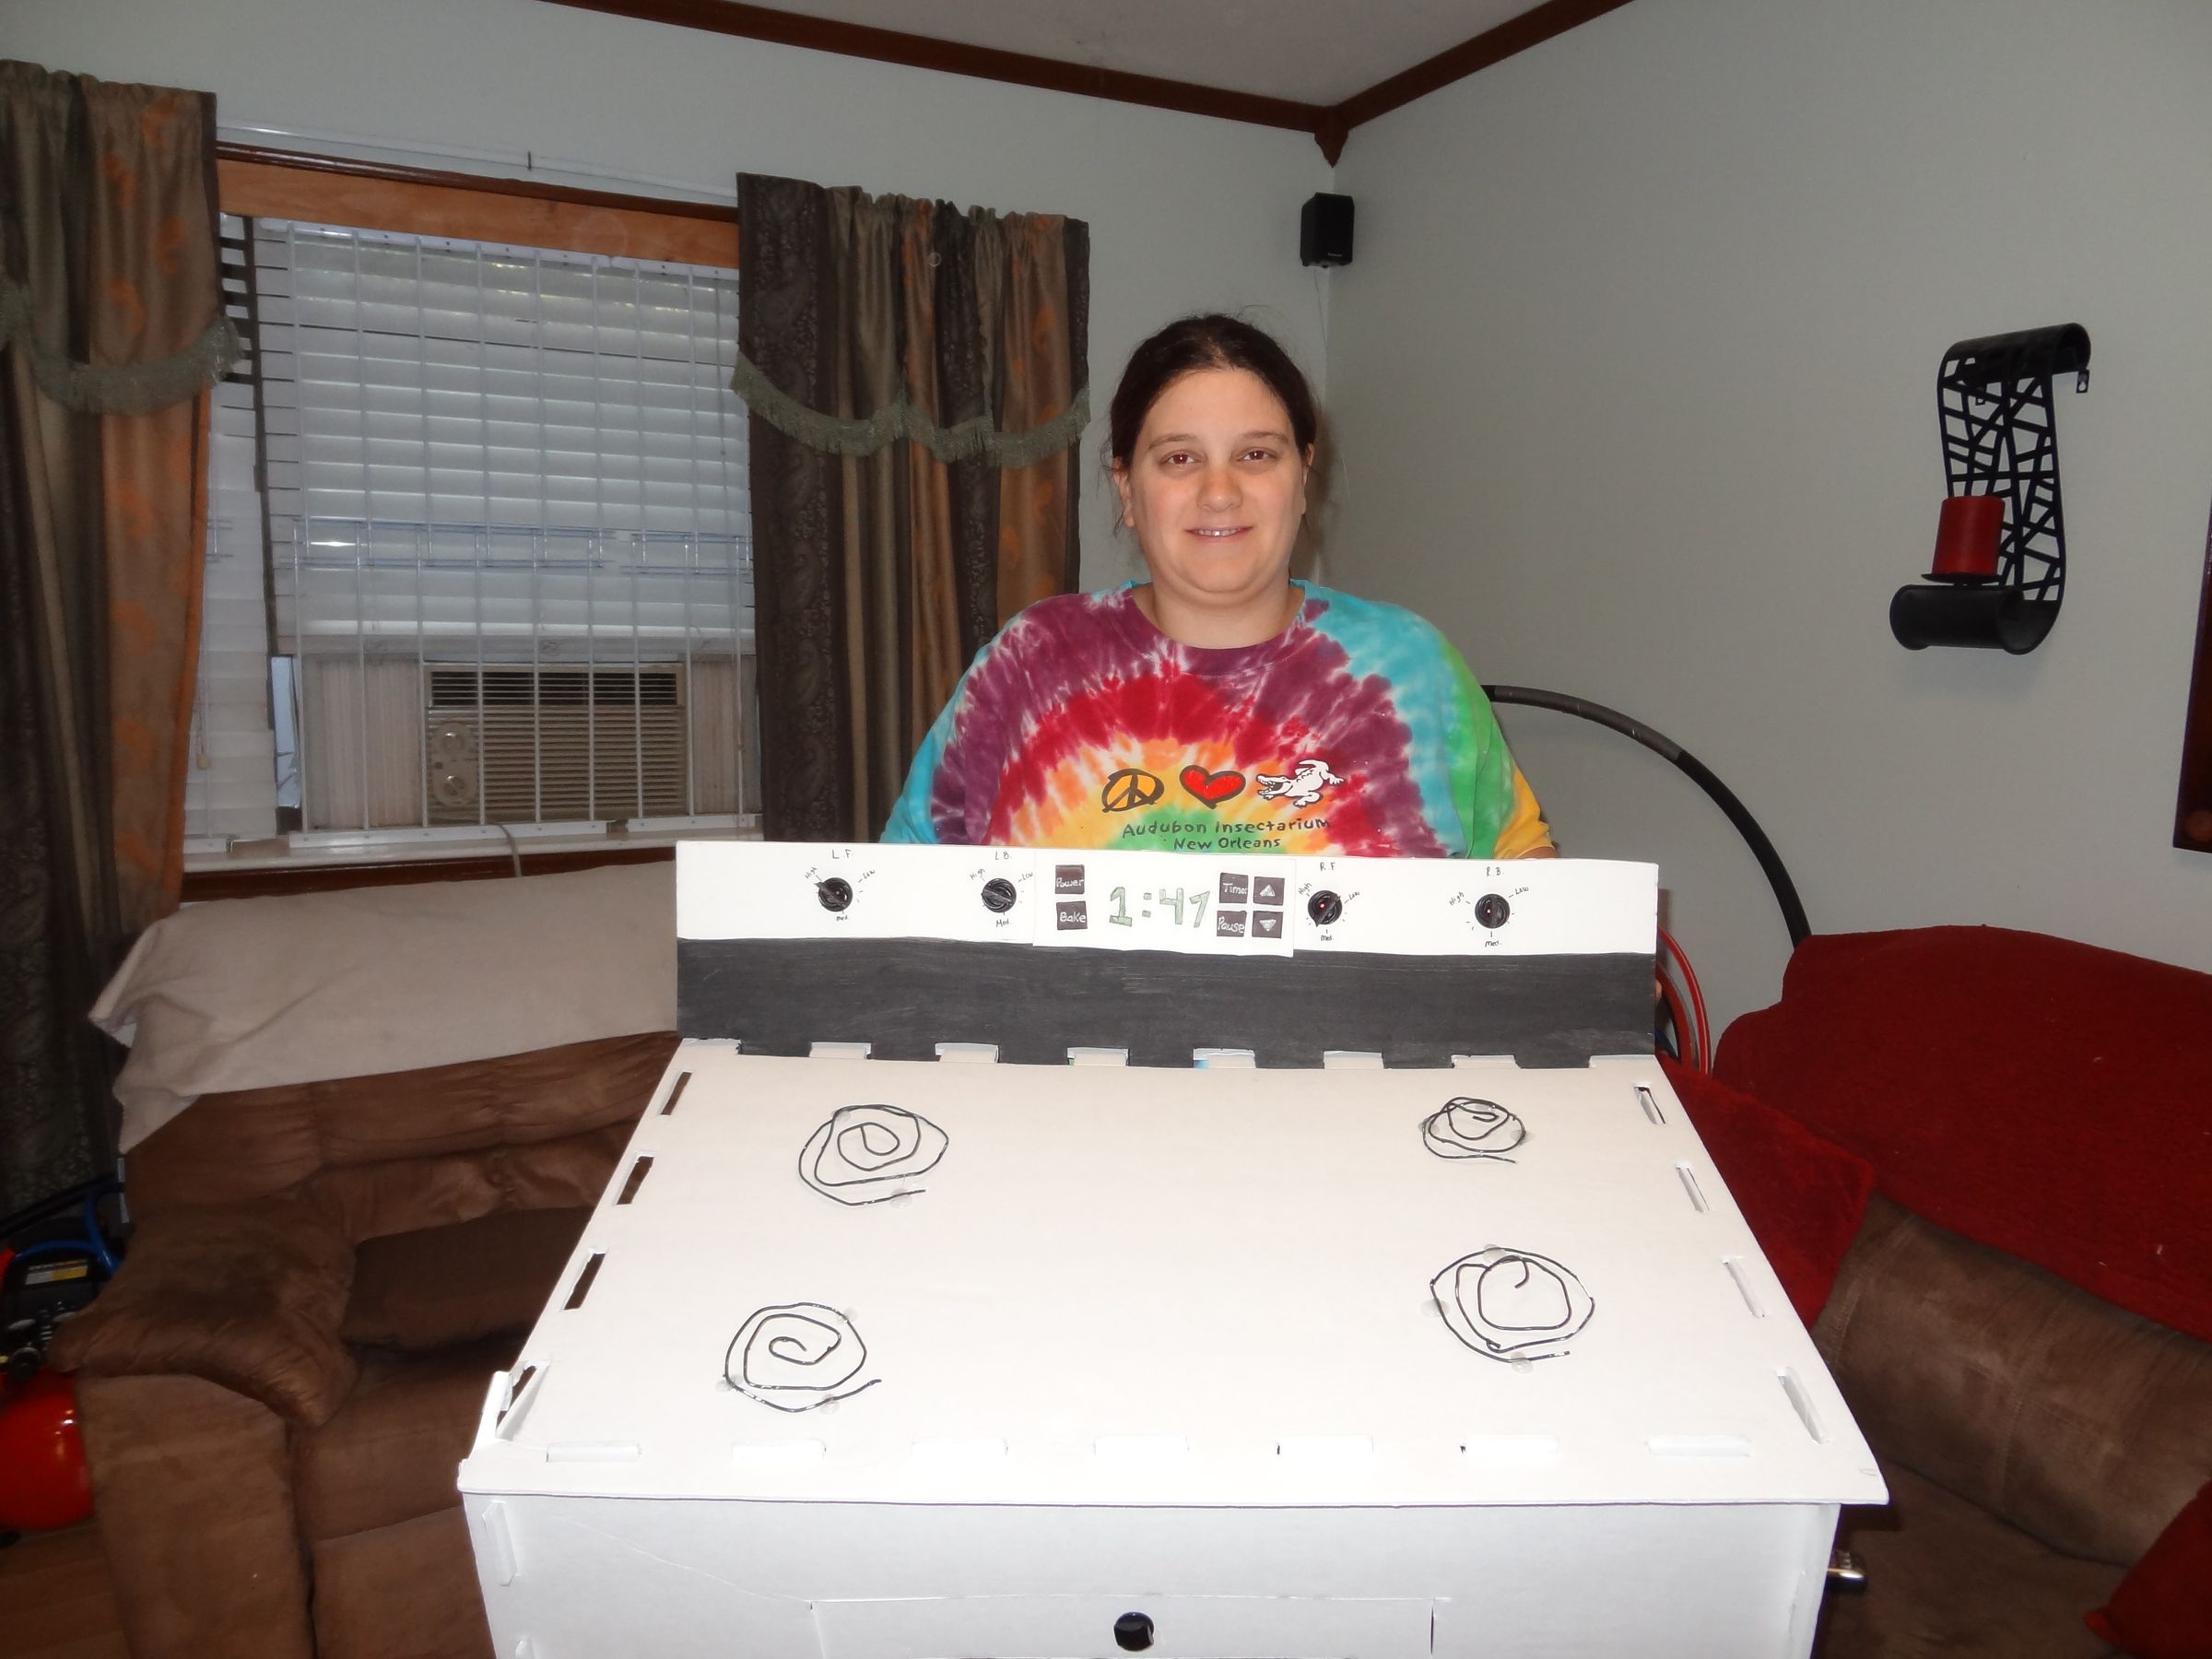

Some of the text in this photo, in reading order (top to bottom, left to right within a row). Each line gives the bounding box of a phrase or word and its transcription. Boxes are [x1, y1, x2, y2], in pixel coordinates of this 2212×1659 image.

[1122, 818, 1331, 839] Audubon Insectarium
[1173, 837, 1280, 851] New Orleans
[805, 865, 818, 880] High
[970, 867, 986, 881] High
[1056, 877, 1085, 888] Power
[1222, 882, 1249, 895] Timer
[1298, 882, 1312, 896] High
[1449, 890, 1465, 906] High
[1059, 911, 1087, 924] Bake
[1217, 915, 1245, 935] Pause
